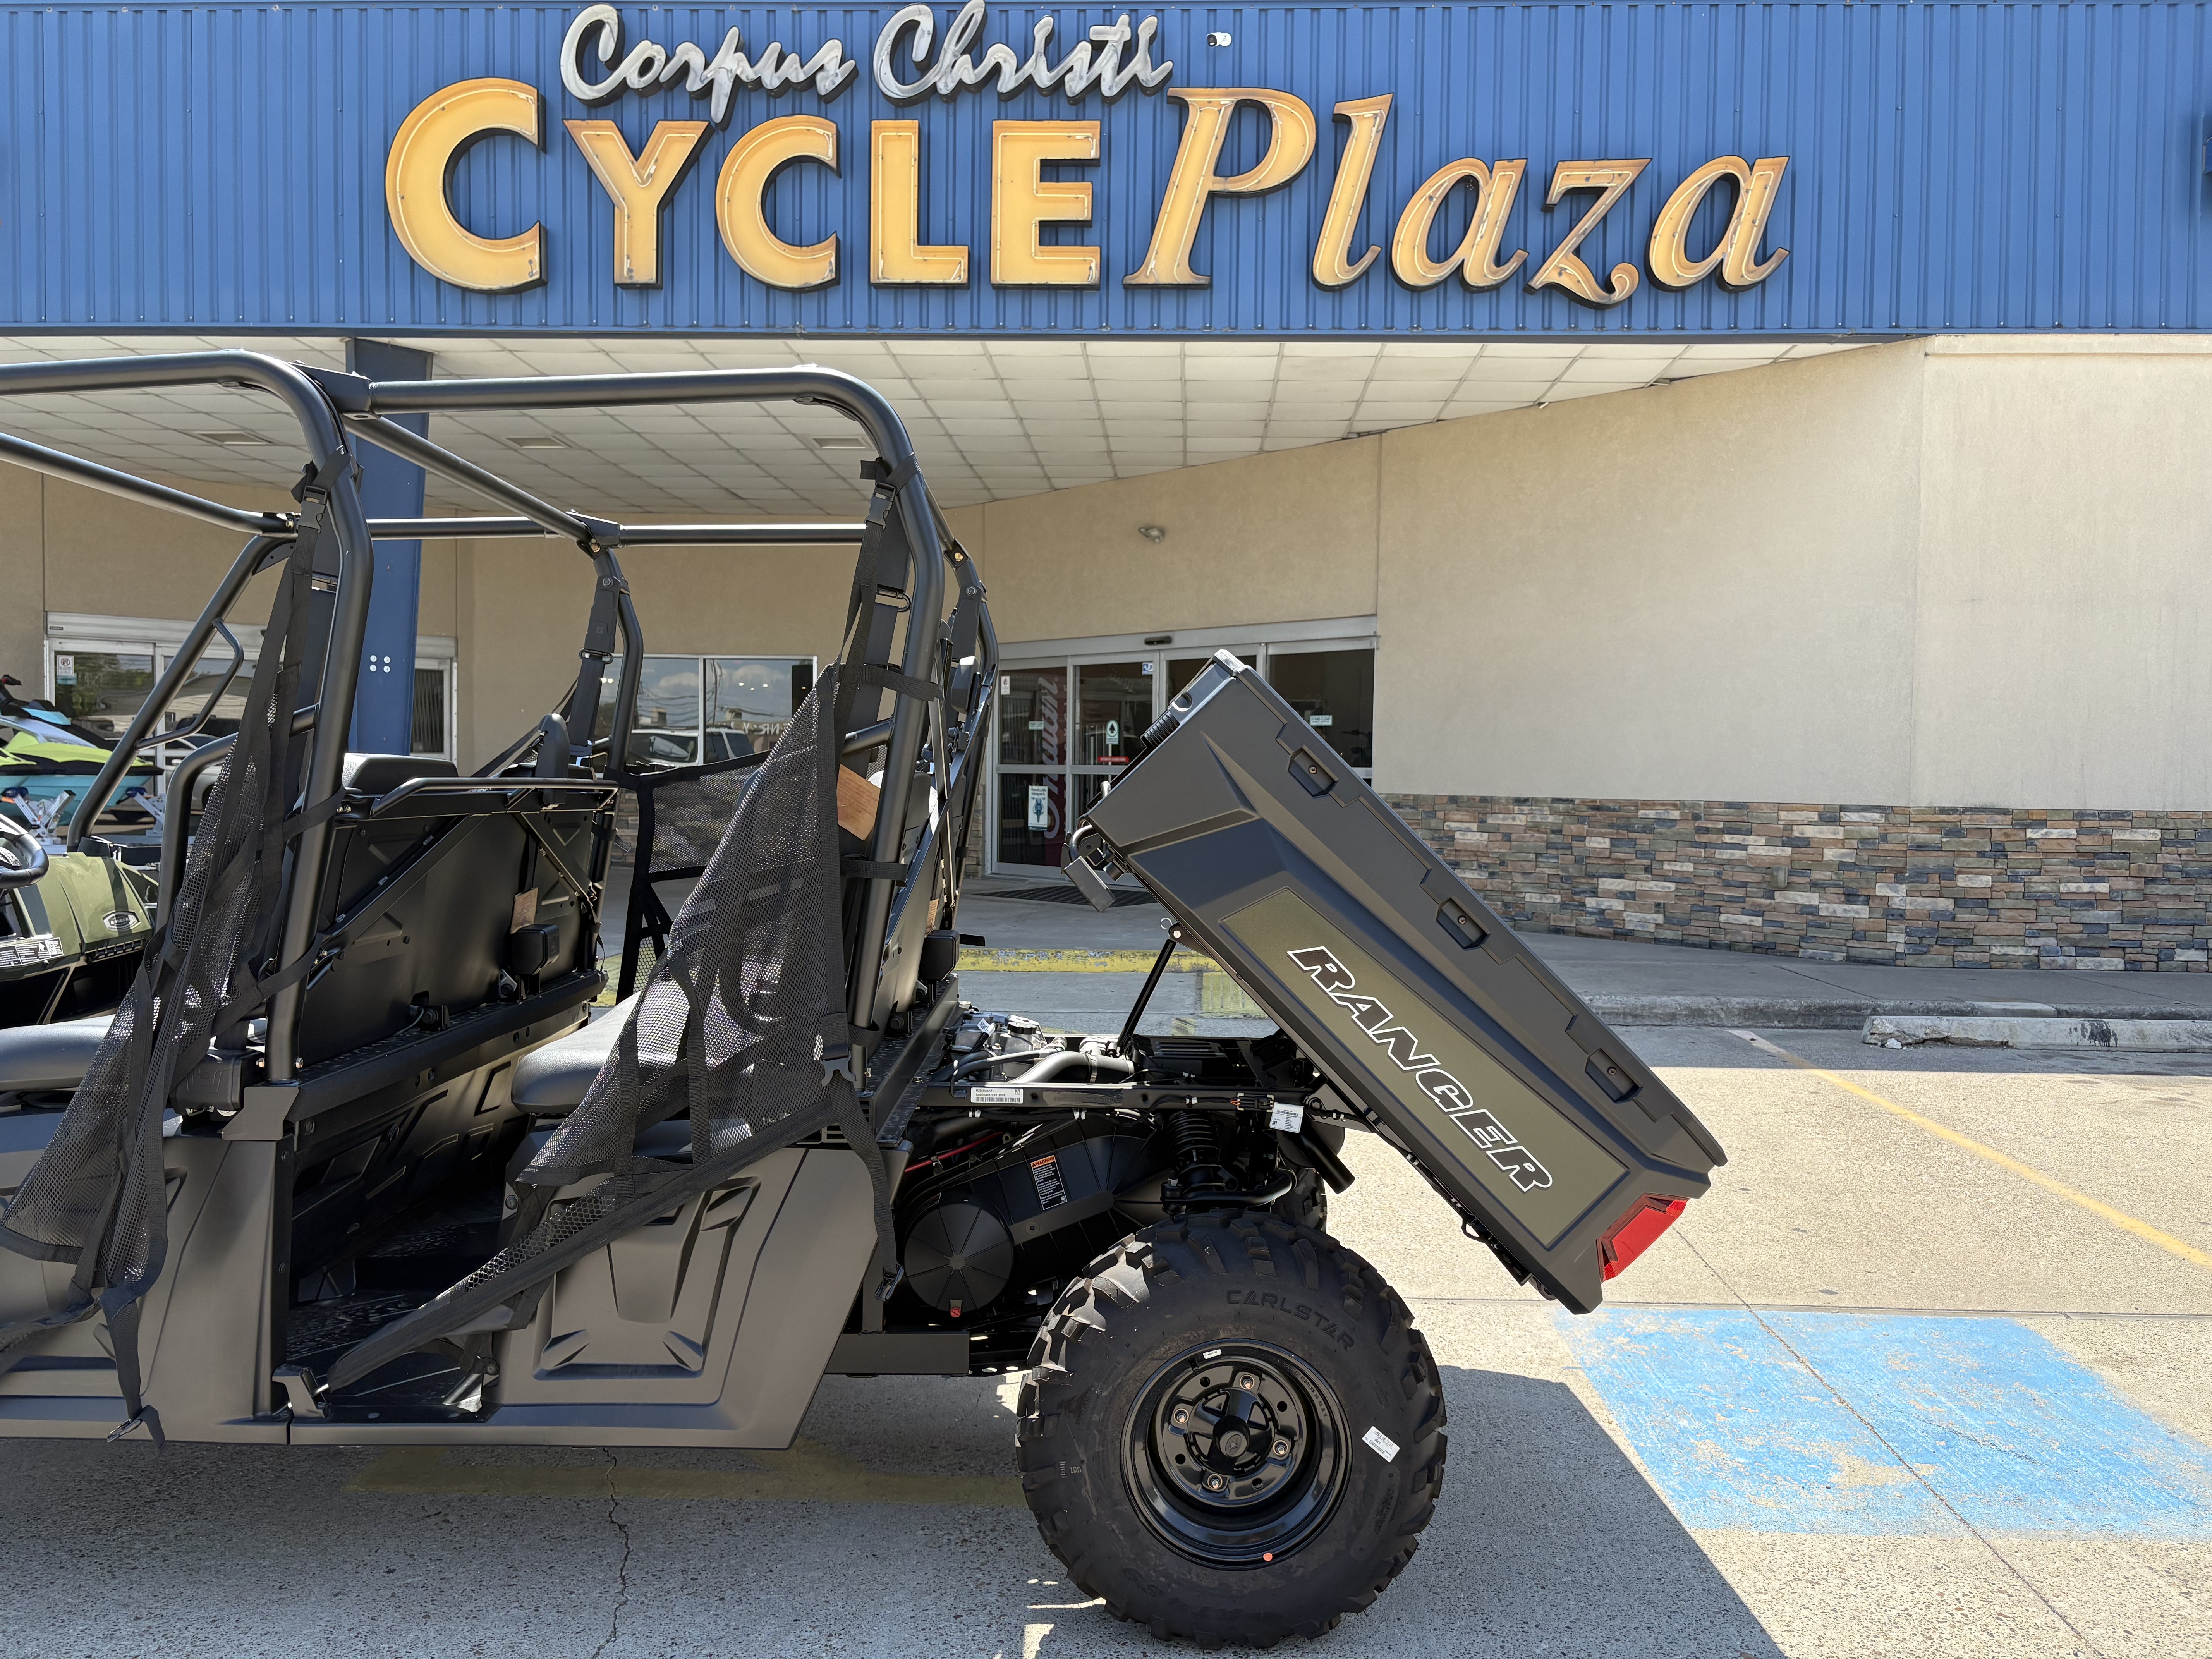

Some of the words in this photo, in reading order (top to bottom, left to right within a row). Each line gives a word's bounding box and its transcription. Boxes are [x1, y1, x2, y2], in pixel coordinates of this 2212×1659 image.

[560, 3, 858, 128] Corpus
[873, 1, 1173, 105] Christi
[385, 77, 1102, 291] CYCLE
[1122, 86, 1790, 309] Plaza
[1287, 946, 1553, 1192] RANGER
[1036, 1156, 1054, 1166] WARNING
[1226, 1289, 1355, 1352] CARLSTAR
